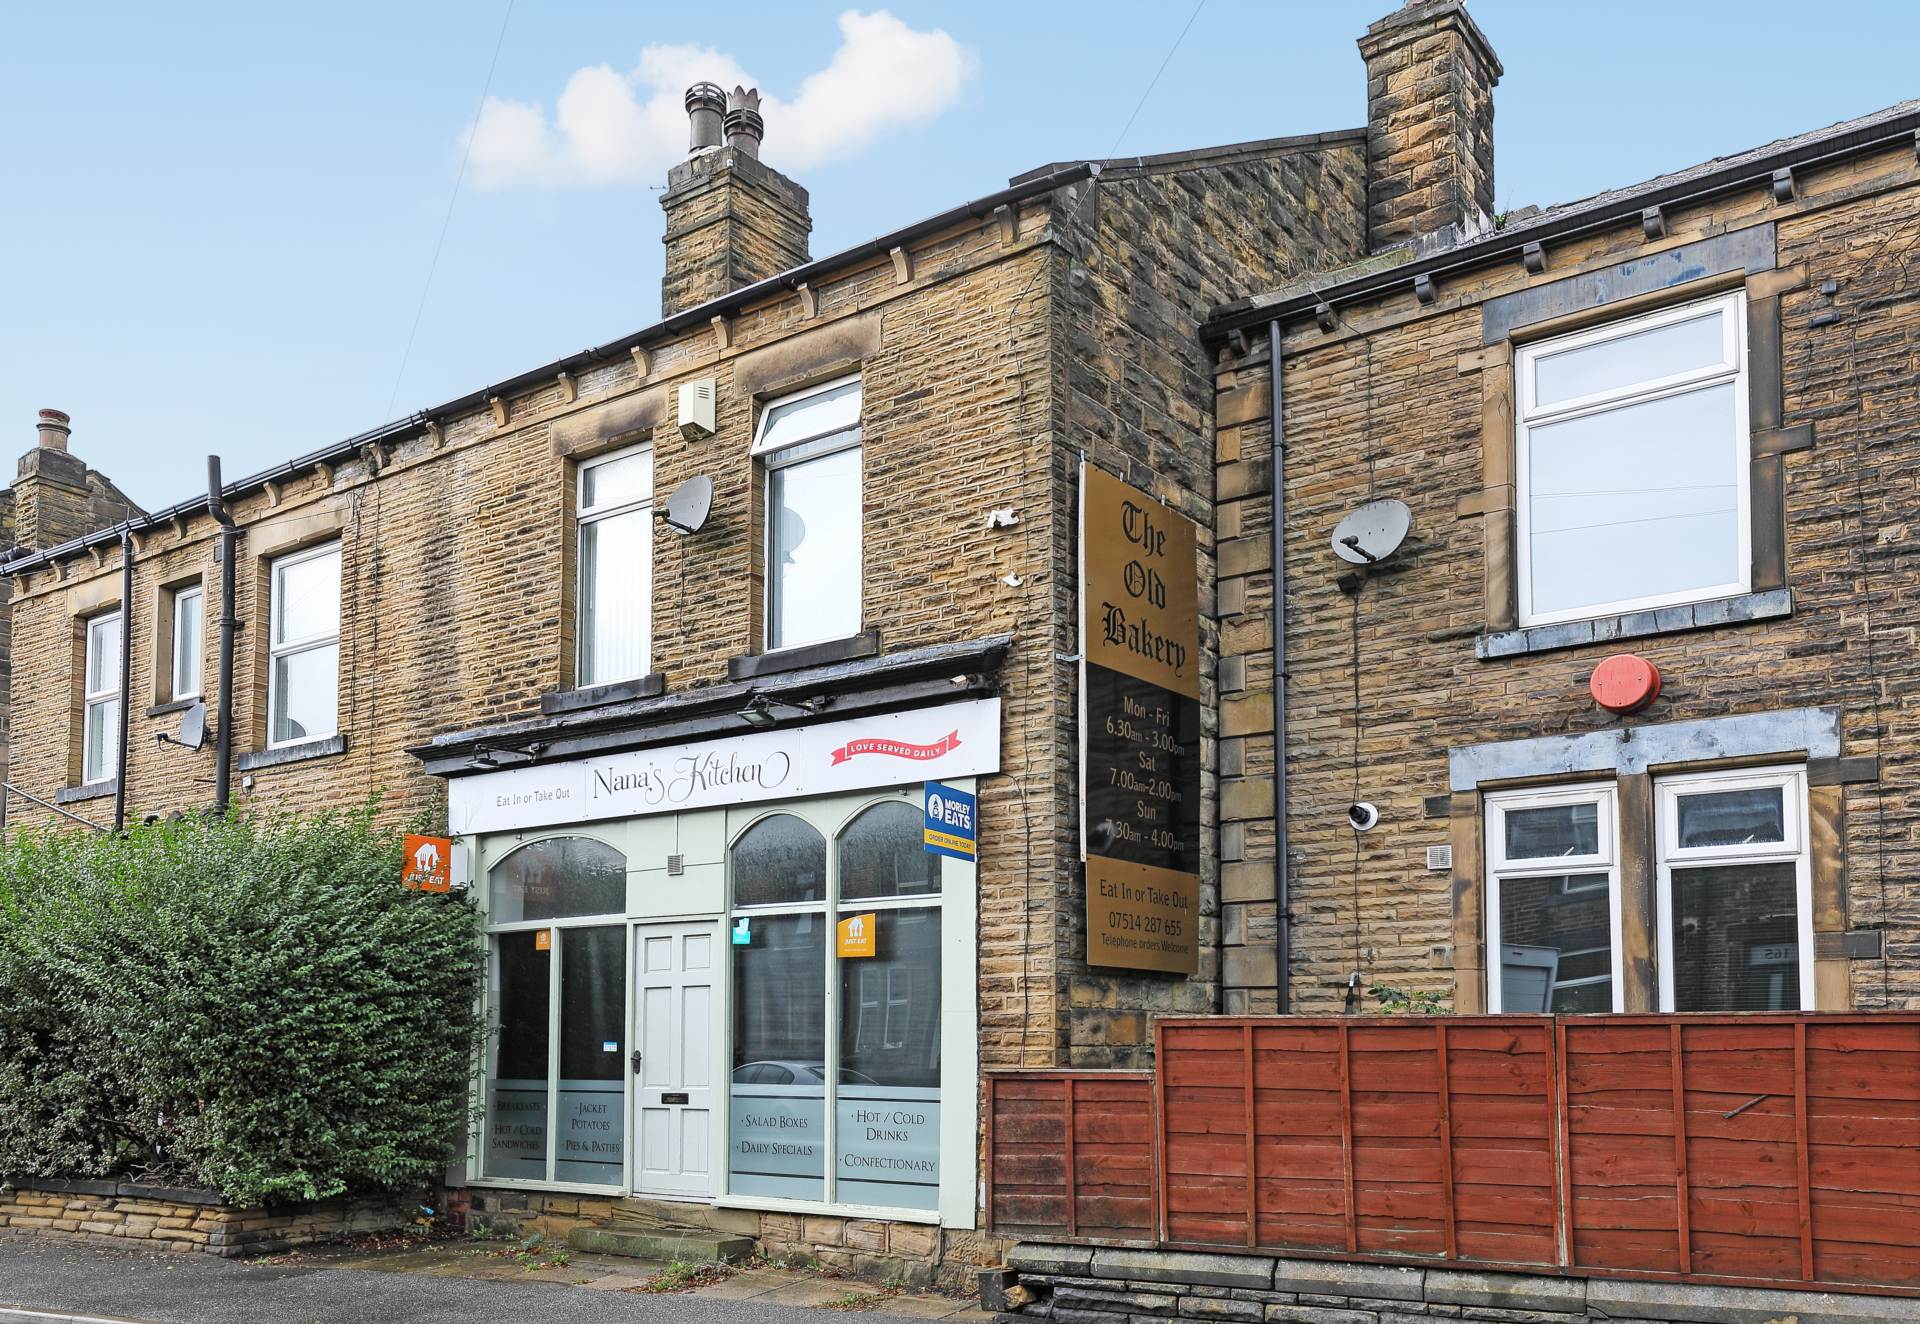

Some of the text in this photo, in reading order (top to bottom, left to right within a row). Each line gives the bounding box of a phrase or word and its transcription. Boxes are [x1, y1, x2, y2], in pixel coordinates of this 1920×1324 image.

[1121, 500, 1166, 557] The
[1124, 560, 1166, 610] Old
[1102, 602, 1186, 678] Bakery
[1124, 695, 1146, 719] Mon
[1156, 707, 1170, 728] Fri
[1106, 715, 1143, 744] 6.30am
[1152, 730, 1185, 756] 3.00pm
[850, 743, 941, 758] LOVE SERVED DAILY
[1139, 751, 1156, 771] Sat
[593, 751, 790, 805] Nana's Kitchen
[496, 787, 570, 807] Eat In or Take Out
[944, 798, 971, 815] MORLEY
[944, 809, 971, 830] EATS
[1137, 800, 1156, 820] Sun
[1151, 828, 1185, 851] 4.00pm
[429, 876, 445, 885] EAT
[1100, 879, 1188, 909] Eat In or Take Out
[1109, 912, 1182, 937] 07514 287 655
[1101, 933, 1137, 950] Telephone
[579, 1102, 608, 1115] JACKET
[857, 1110, 881, 1123] HOT
[893, 1111, 925, 1124] COLD
[571, 1118, 611, 1130] POTATOES
[745, 1114, 808, 1128] SALAD BOXES
[866, 1127, 908, 1141] DRINKS
[566, 1140, 621, 1153] PIES & PASTIES
[741, 1141, 813, 1156] DAILY SPECIALS
[844, 1153, 936, 1172] CONFECTIONARY
